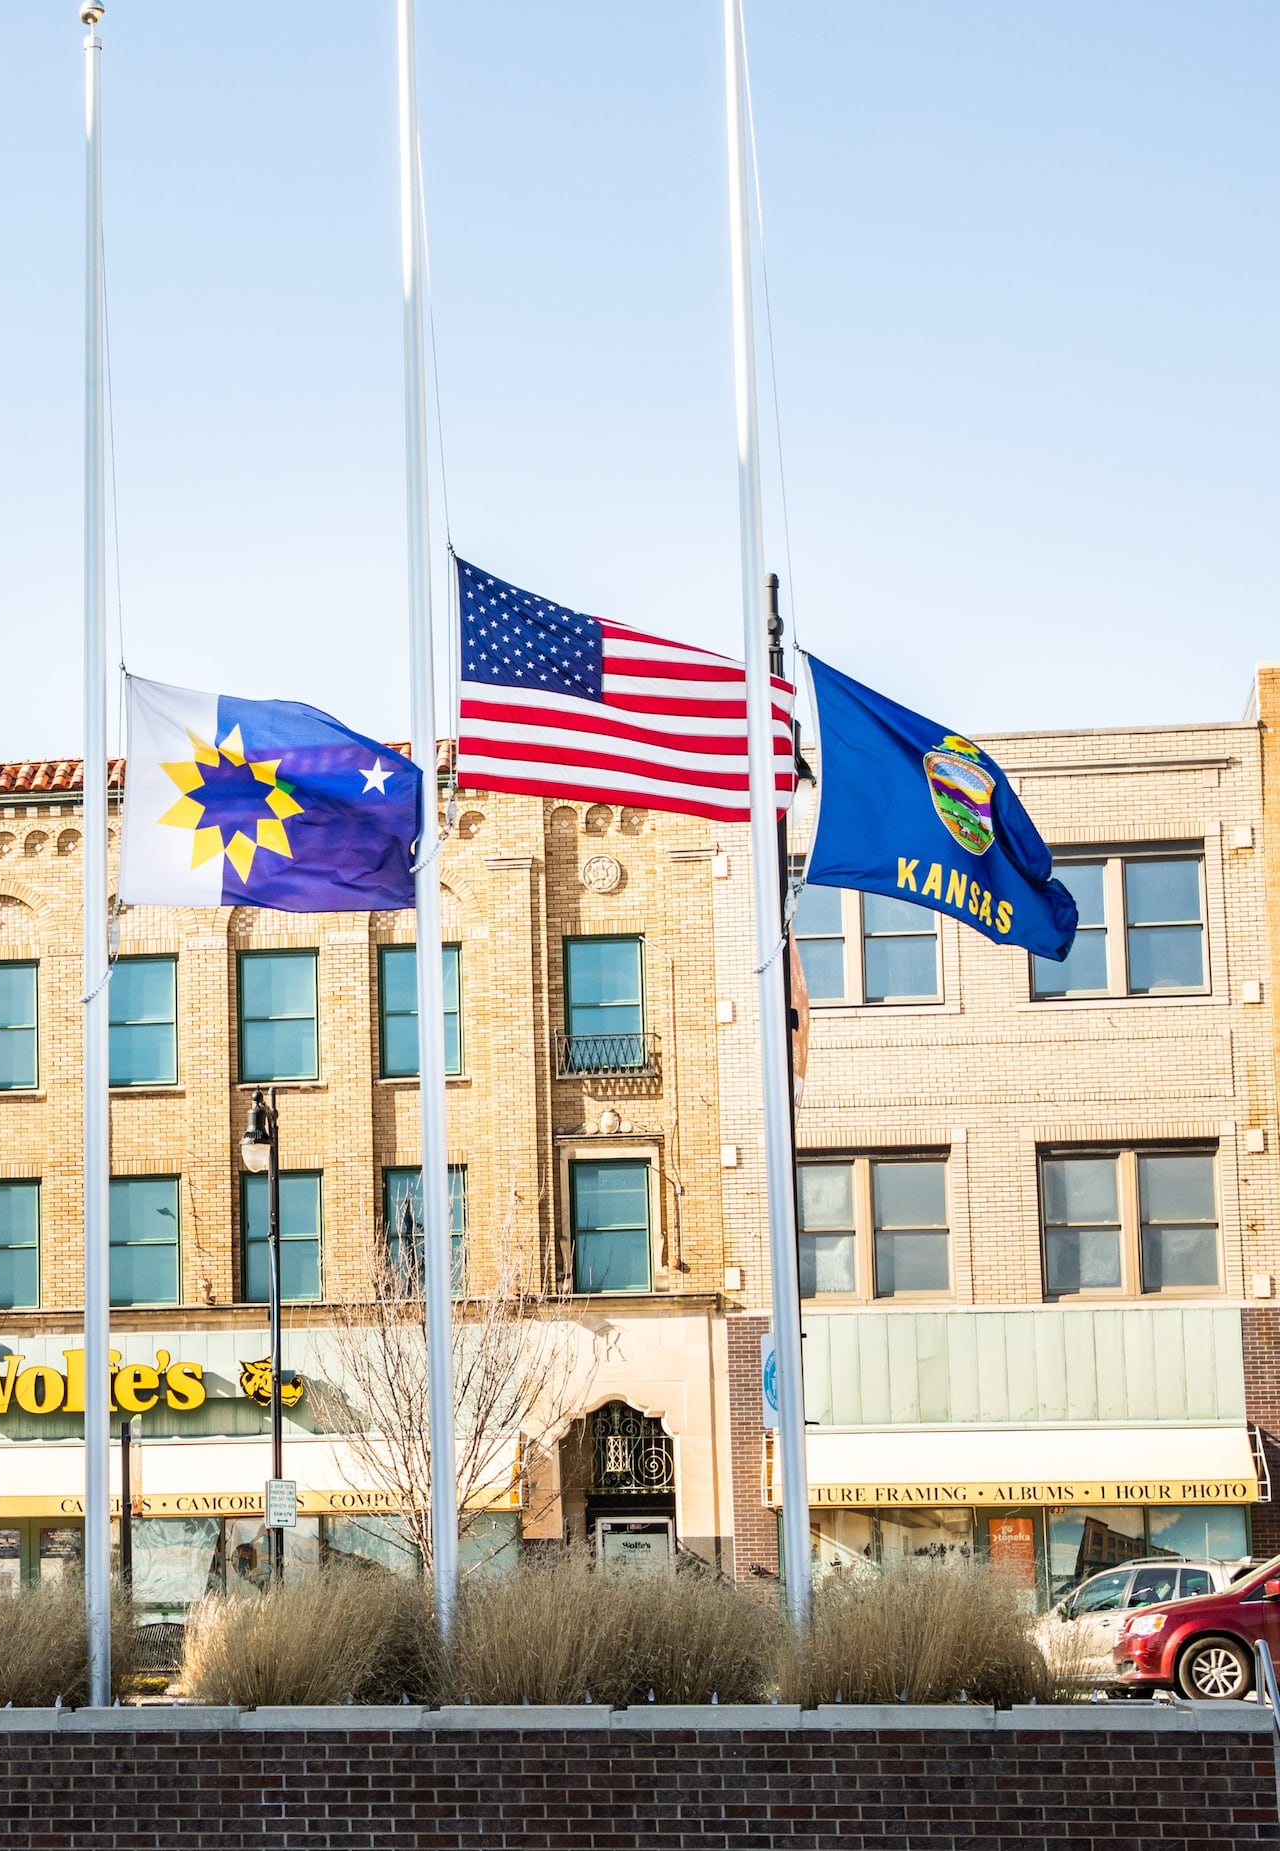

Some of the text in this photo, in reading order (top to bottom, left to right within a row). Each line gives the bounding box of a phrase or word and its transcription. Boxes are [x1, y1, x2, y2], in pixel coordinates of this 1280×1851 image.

[896, 856, 1014, 935] KANSAS
[810, 1483, 1247, 1502] TURE FRAMING ALBUMS 1 HOUR PHOTO
